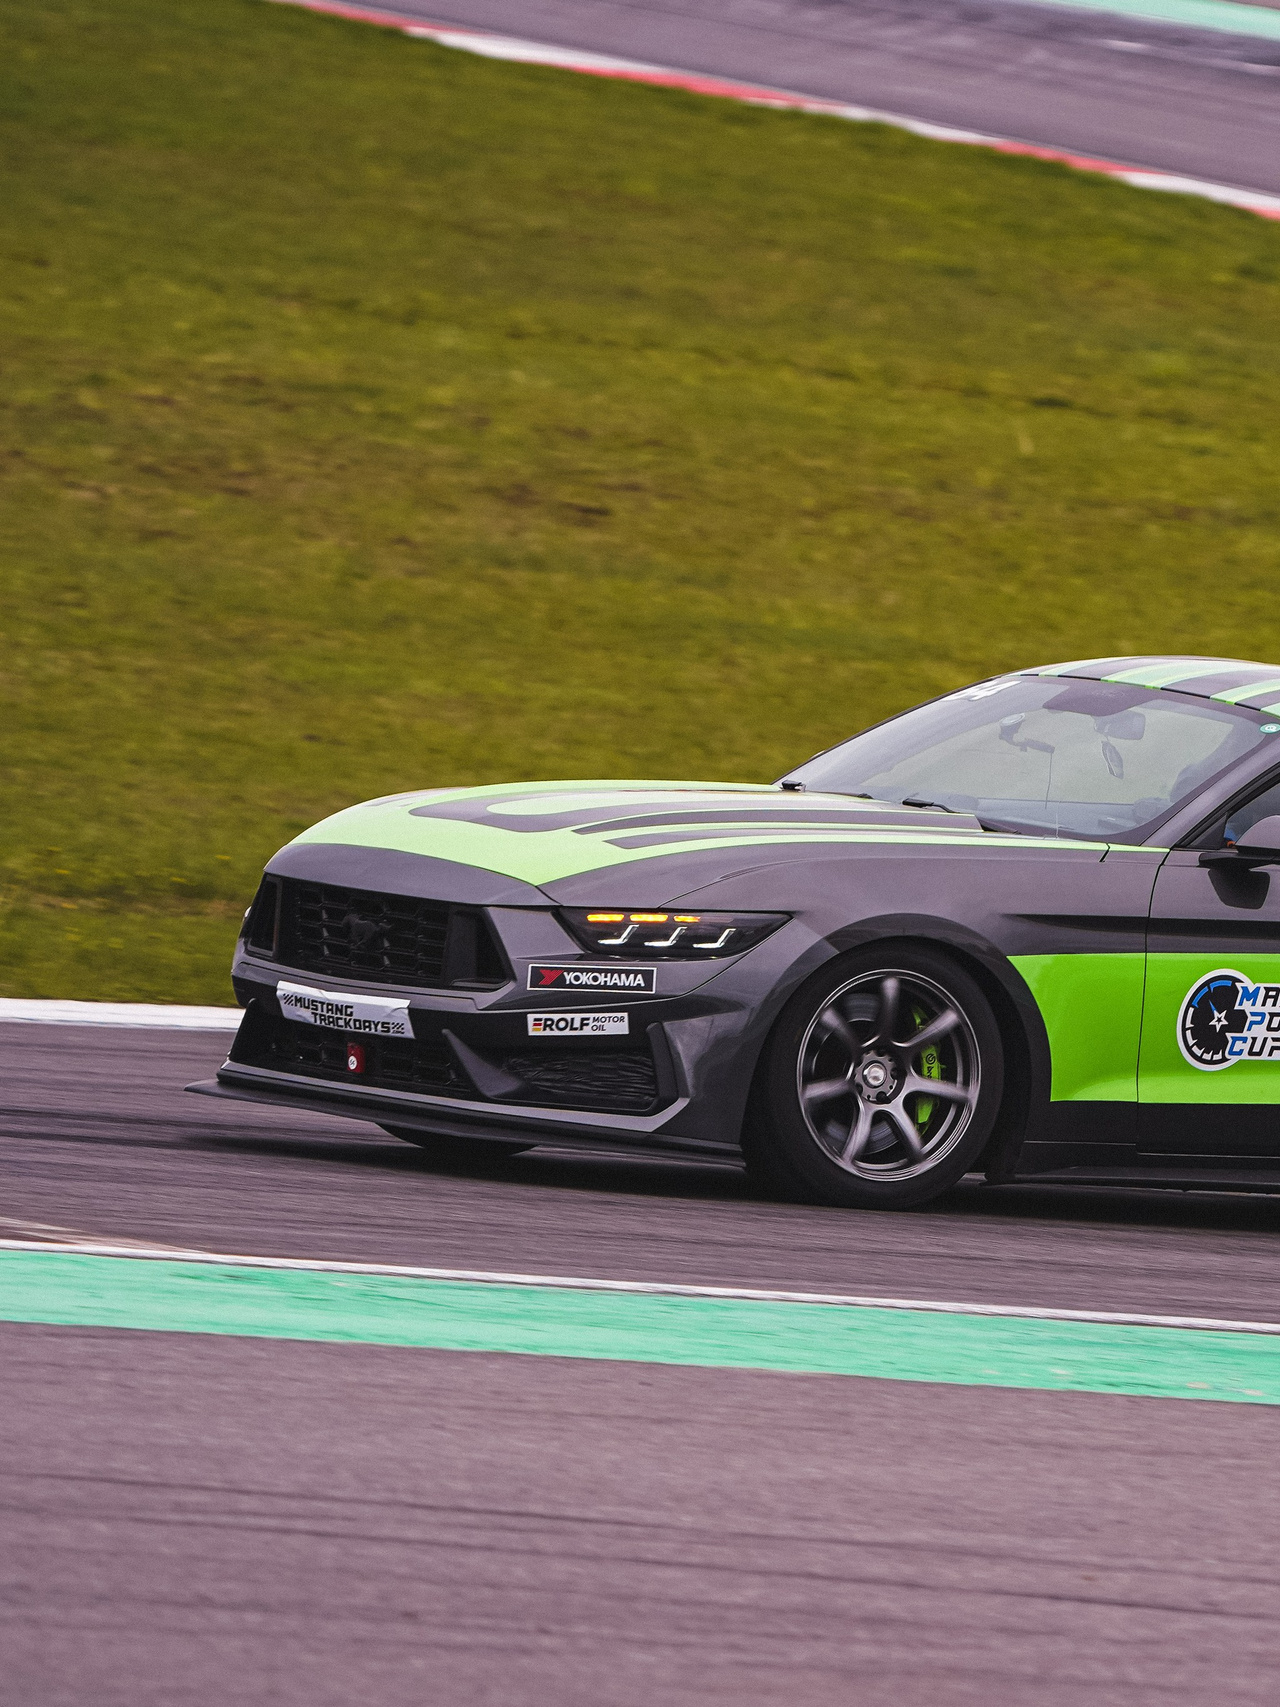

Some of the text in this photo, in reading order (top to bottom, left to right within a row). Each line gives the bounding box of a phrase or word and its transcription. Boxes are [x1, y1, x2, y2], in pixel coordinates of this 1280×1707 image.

[563, 971, 645, 987] YOKOHAMA
[294, 995, 354, 1017] MUSTANG
[311, 1011, 391, 1033] TRACKDAYS
[542, 1017, 590, 1032] ROLF
[592, 1015, 625, 1024] MOTOR
[591, 1024, 606, 1032] OIL
